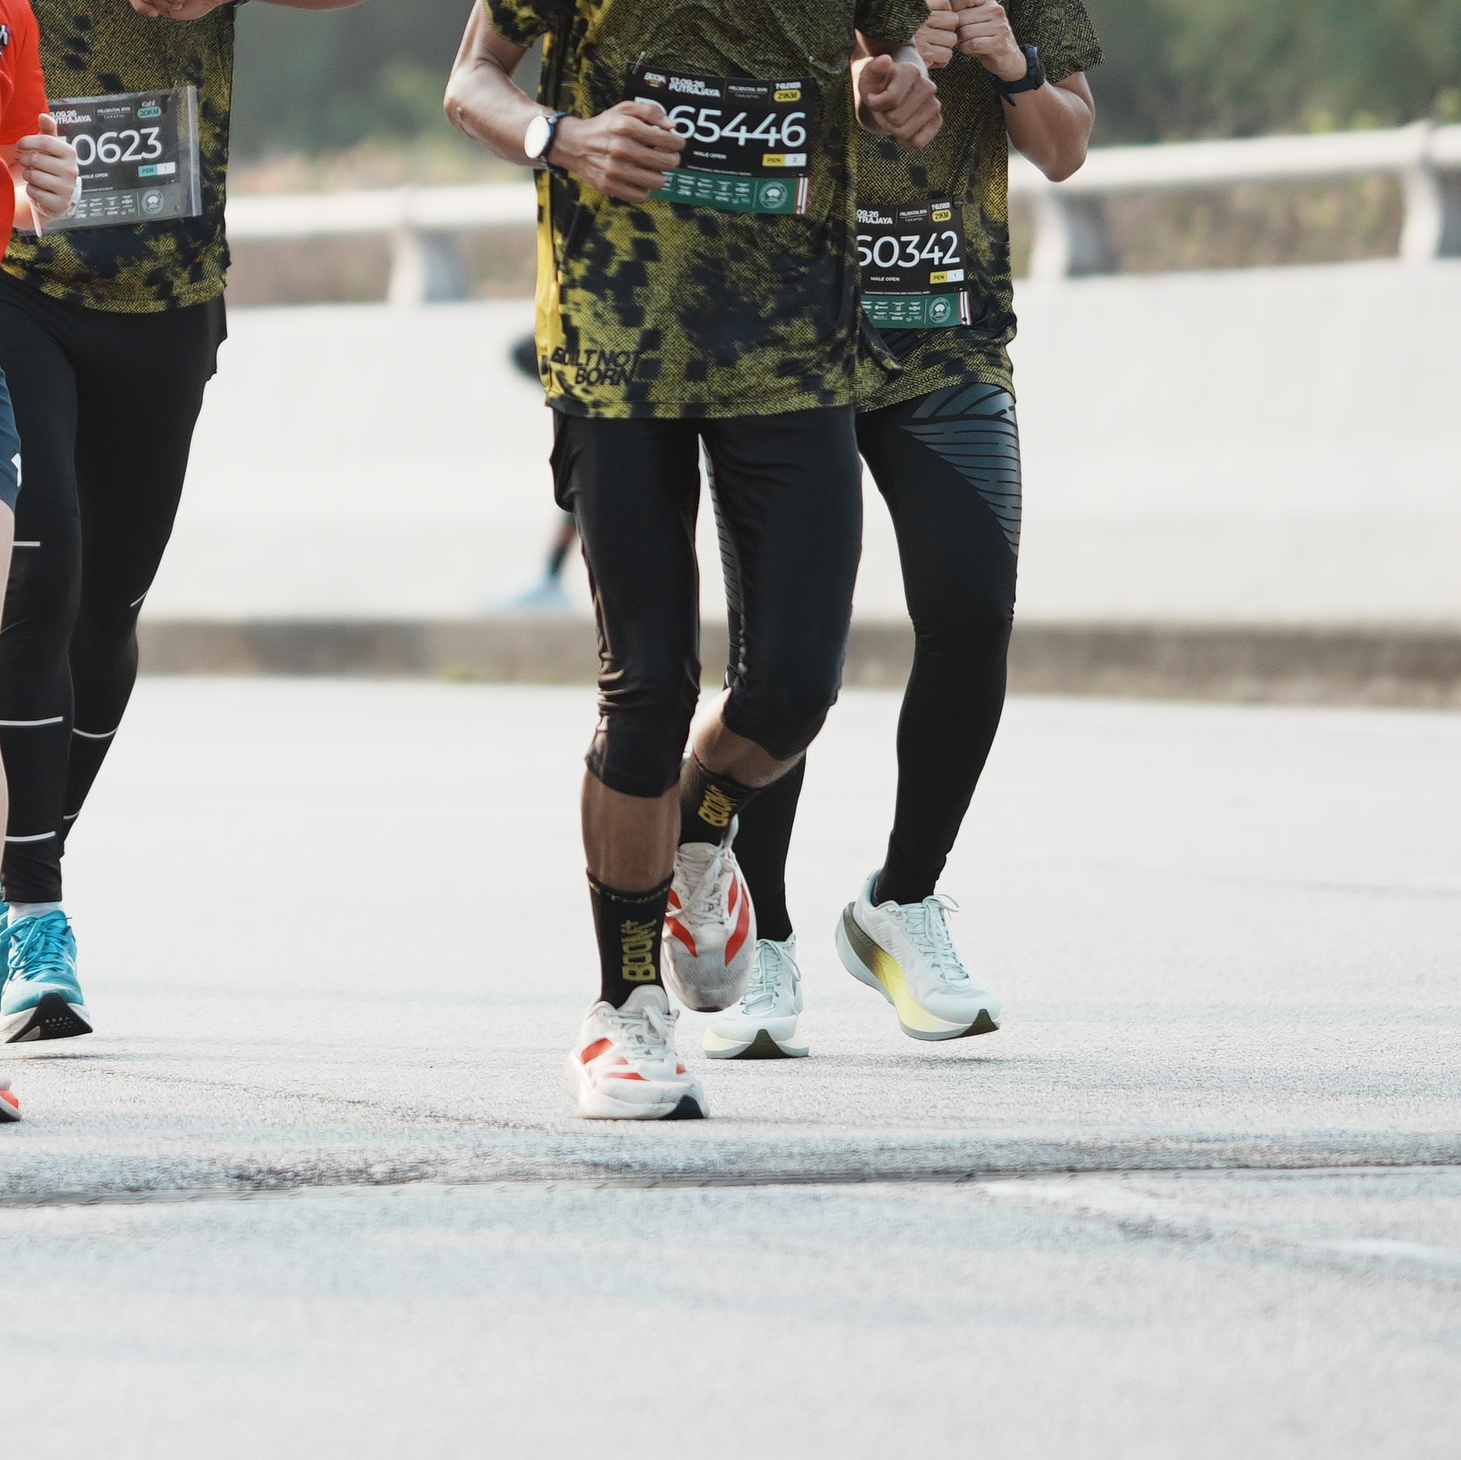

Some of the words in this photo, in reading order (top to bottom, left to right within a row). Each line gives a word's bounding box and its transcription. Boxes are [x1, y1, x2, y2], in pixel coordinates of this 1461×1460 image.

[668, 83, 721, 98] PUTRAJAYA
[857, 216, 893, 224] TRAJAYA
[620, 919, 657, 980] BOOM
